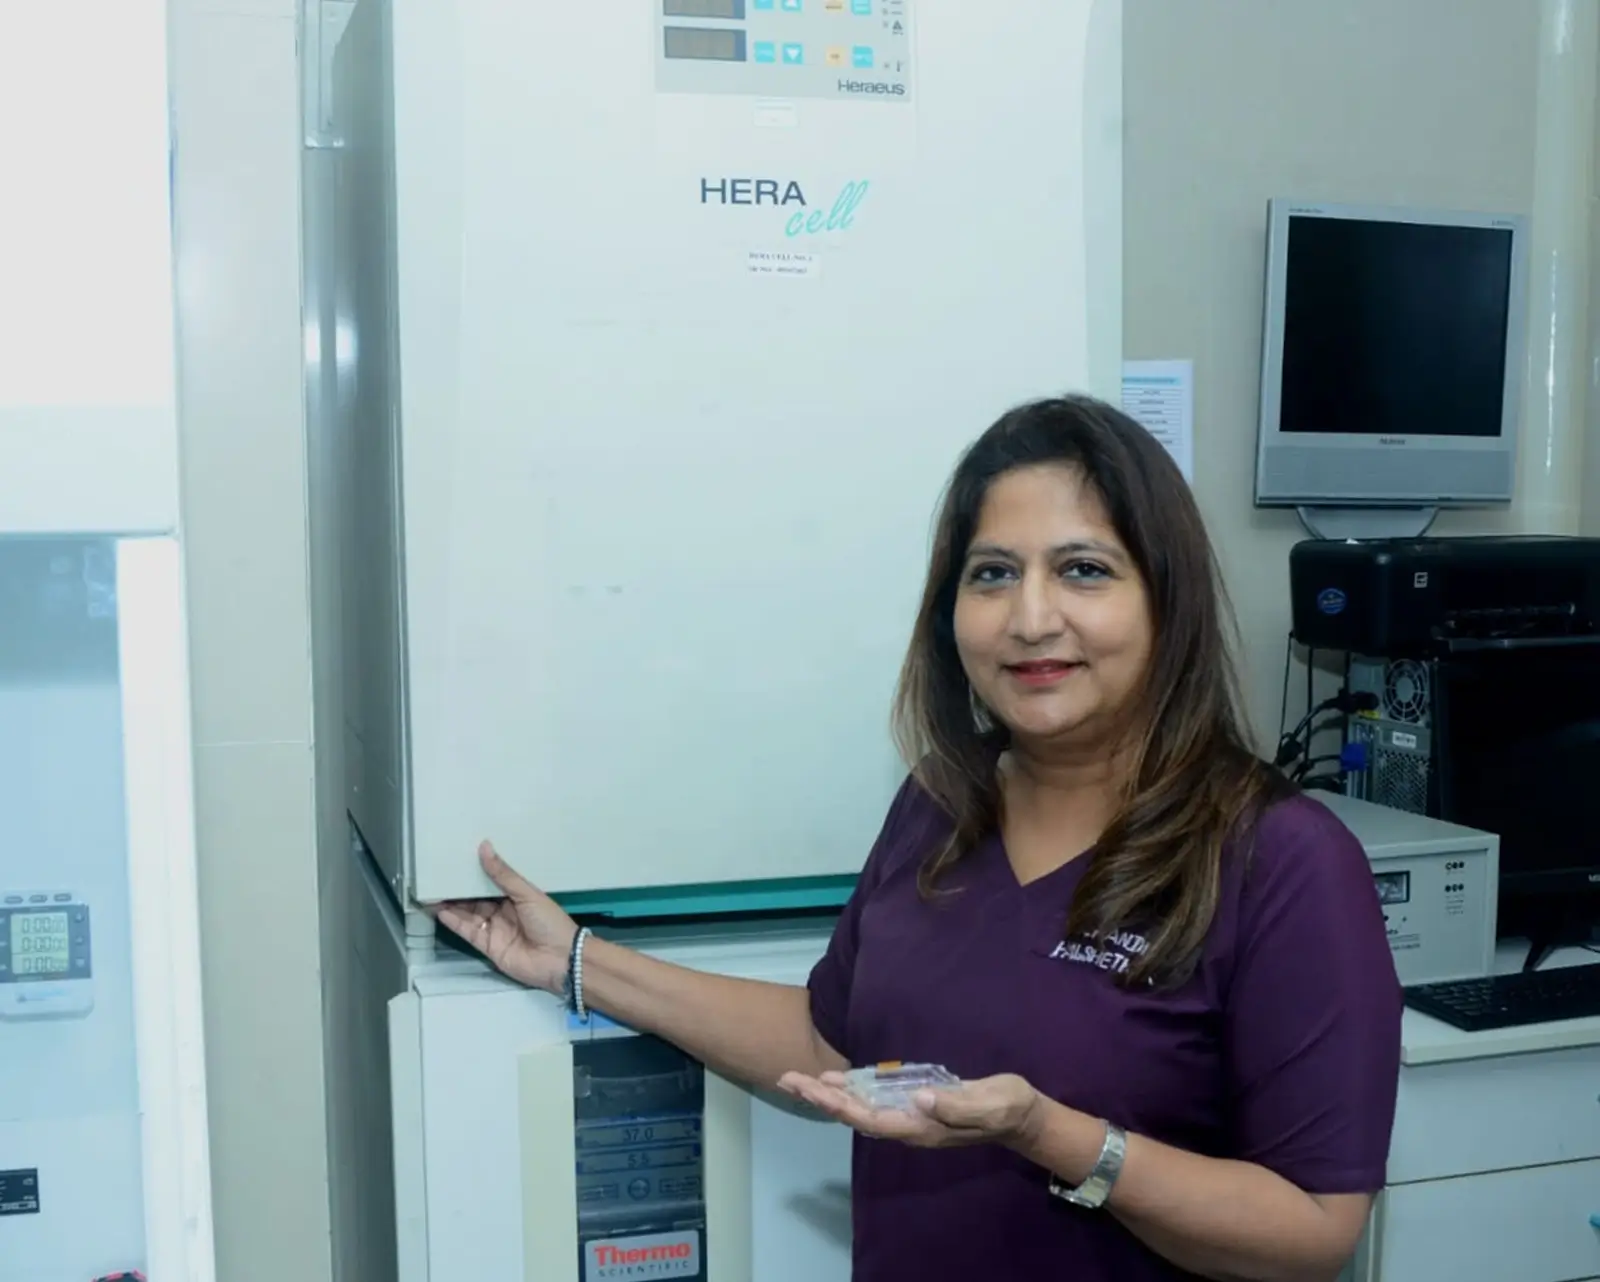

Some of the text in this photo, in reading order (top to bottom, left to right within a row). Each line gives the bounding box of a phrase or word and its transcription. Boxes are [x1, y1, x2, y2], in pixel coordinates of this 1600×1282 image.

[837, 79, 905, 95] Heraeus
[700, 178, 807, 206] HERA
[785, 179, 869, 237] cell
[594, 1243, 692, 1267] Thermo
[597, 1260, 690, 1278] SCIENTIFIC
